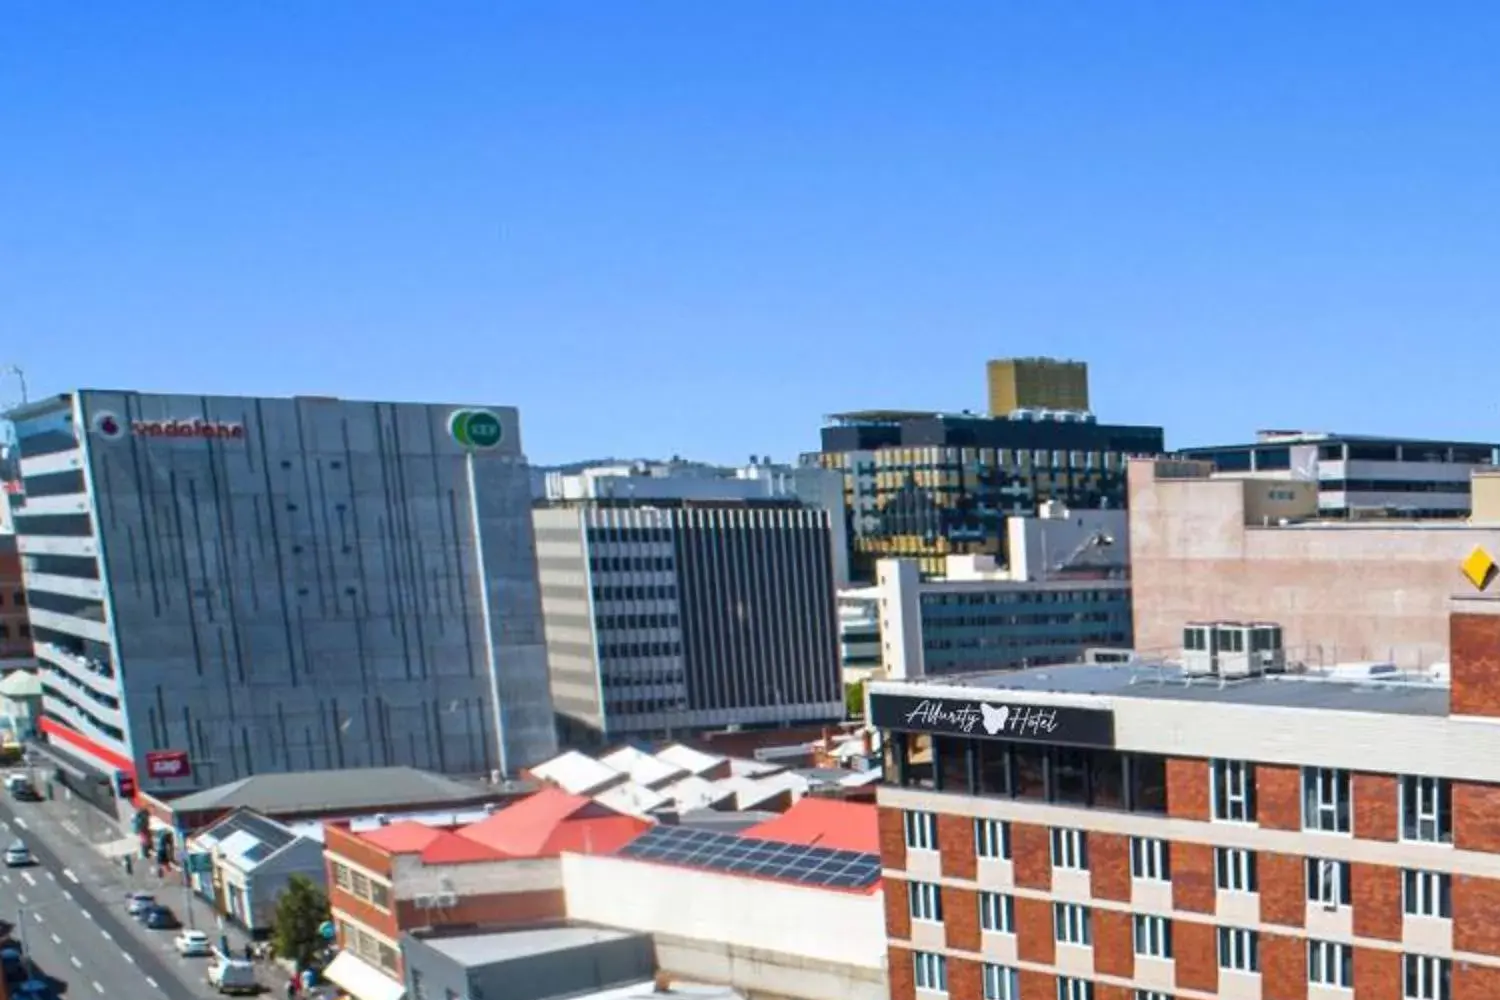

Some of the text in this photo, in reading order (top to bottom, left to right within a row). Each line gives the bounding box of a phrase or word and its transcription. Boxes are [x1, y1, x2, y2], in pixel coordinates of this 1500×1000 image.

[132, 418, 243, 438] vodafone
[905, 700, 1058, 736] Allurity Hotel
